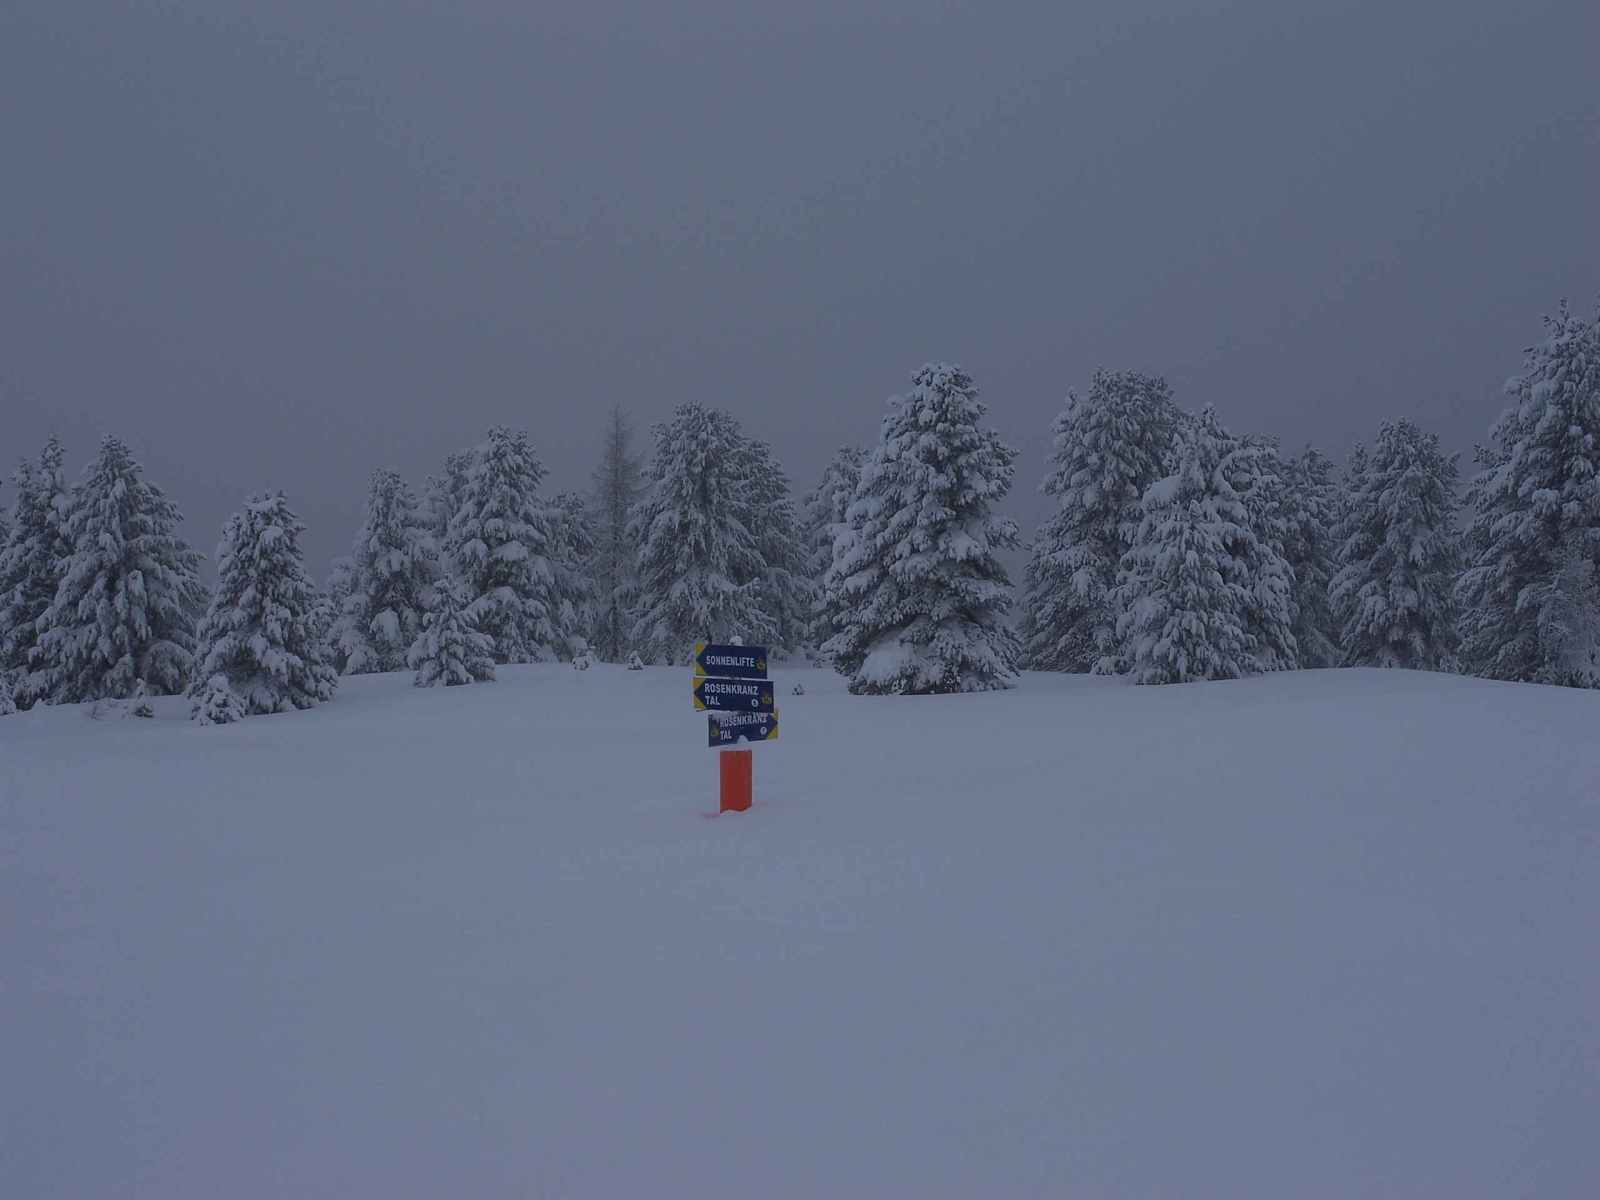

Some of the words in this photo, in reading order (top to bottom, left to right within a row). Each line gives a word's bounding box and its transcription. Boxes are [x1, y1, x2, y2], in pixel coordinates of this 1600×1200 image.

[706, 655, 755, 667] SONNENLIFTE
[704, 683, 760, 695] ROSENKRANZ
[705, 695, 720, 705] TAL
[720, 729, 732, 741] TAL
